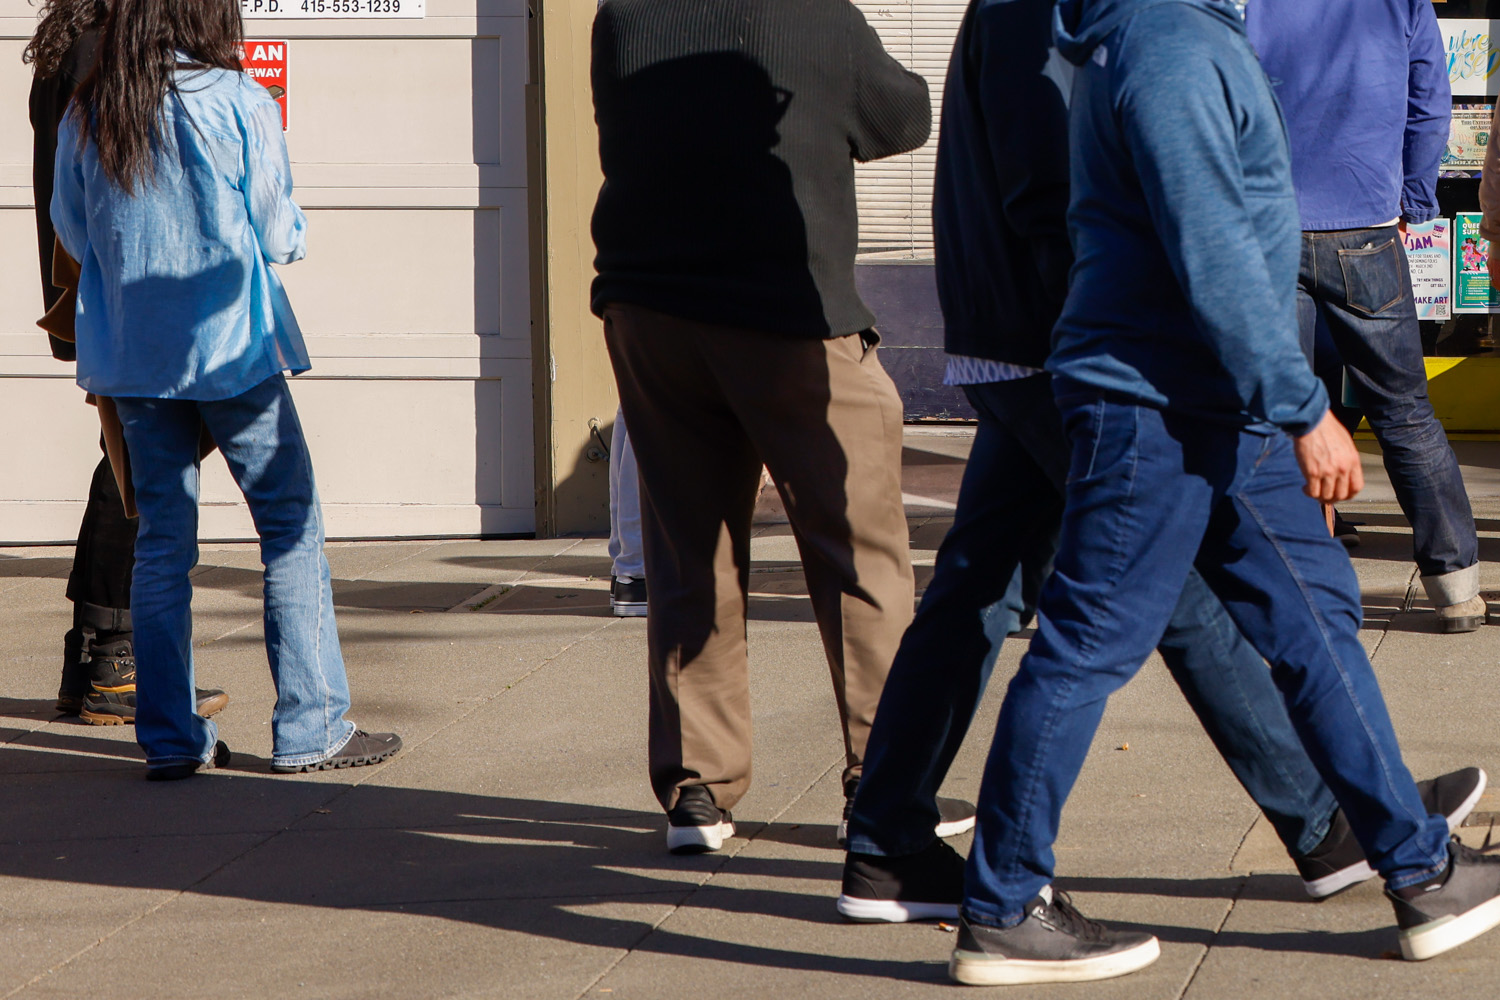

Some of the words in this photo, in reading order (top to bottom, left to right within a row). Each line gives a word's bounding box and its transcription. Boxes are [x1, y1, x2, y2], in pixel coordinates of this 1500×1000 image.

[241, 0, 283, 13] F.P.D.
[301, 0, 401, 13] 415-553-1239
[252, 45, 283, 61] AN
[243, 68, 282, 78] EWAY
[1410, 236, 1433, 251] JAM
[1414, 296, 1432, 304] MAKE
[1434, 296, 1448, 304] ART
